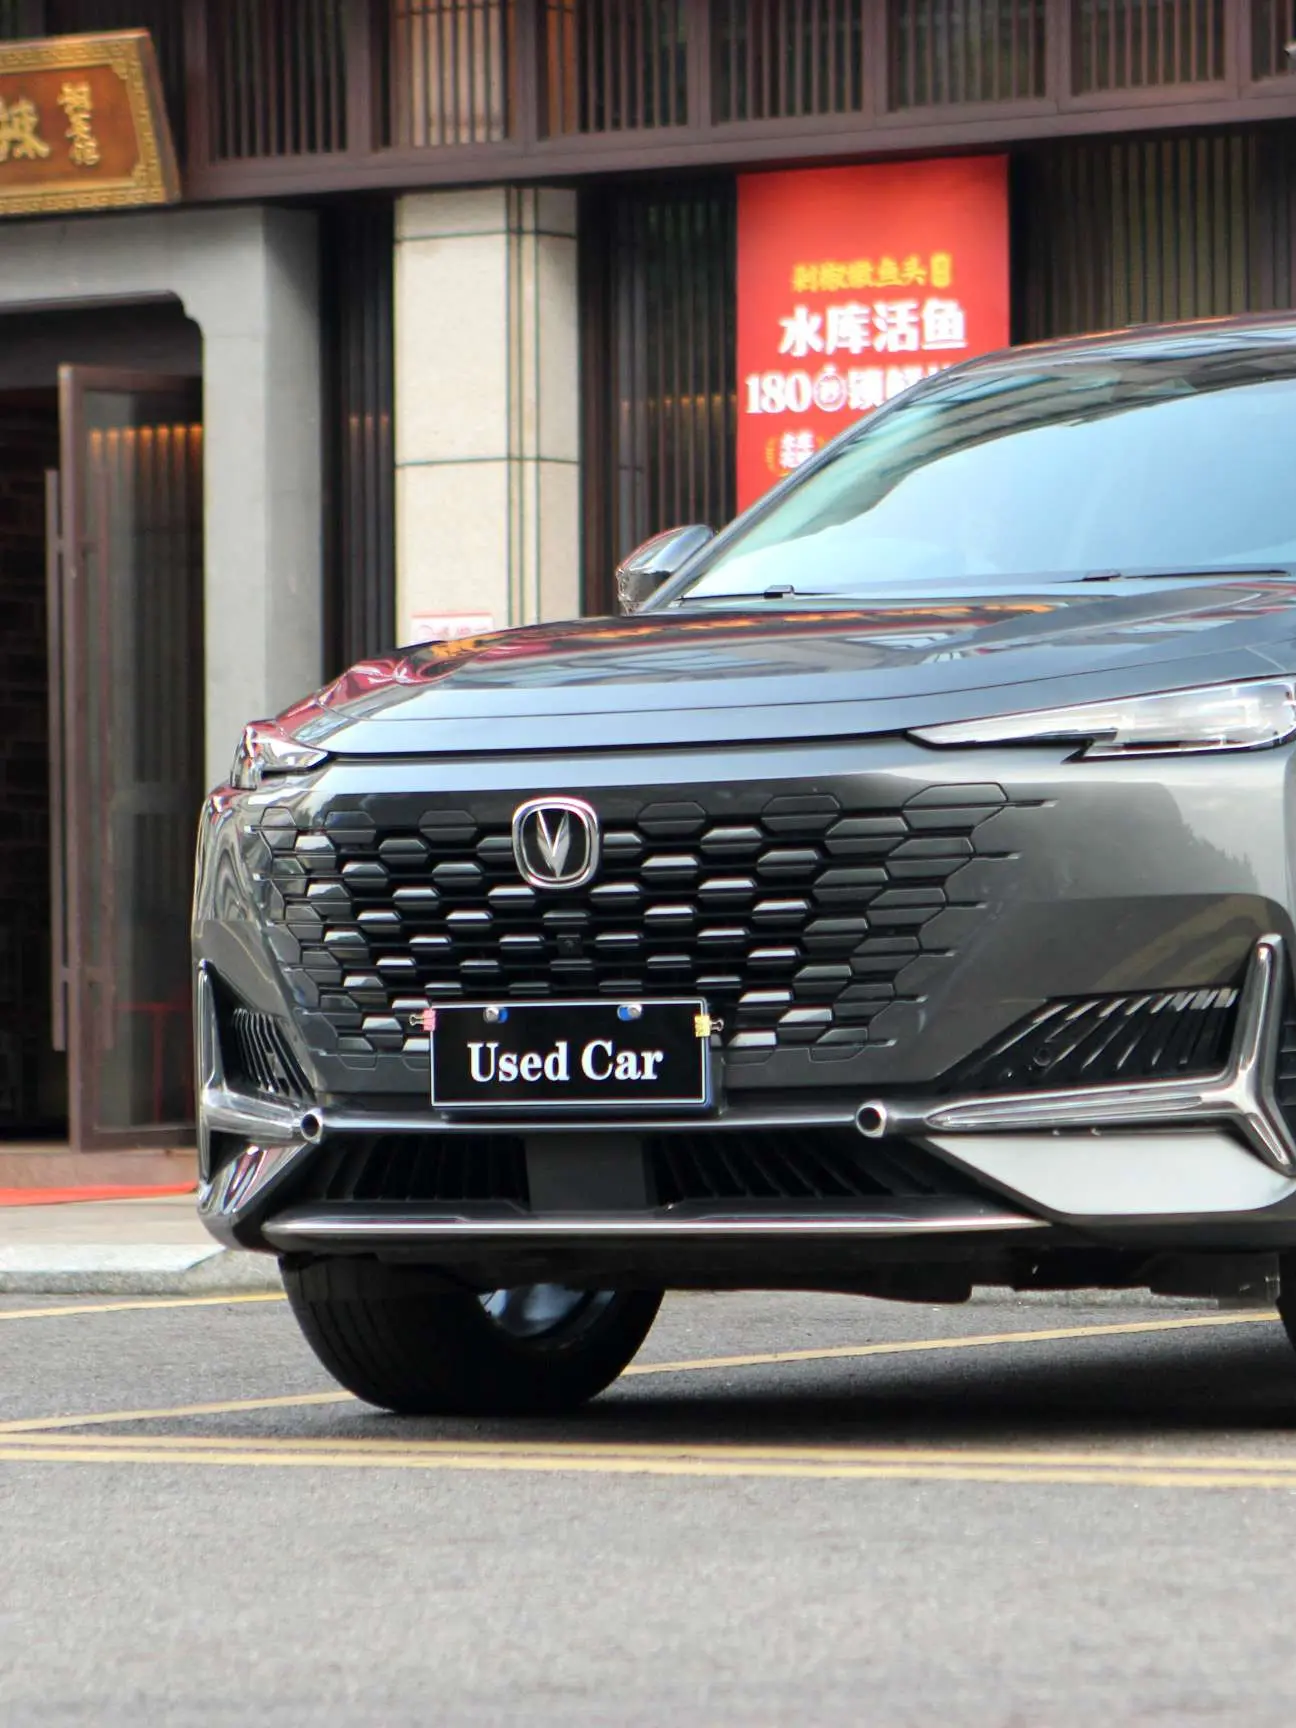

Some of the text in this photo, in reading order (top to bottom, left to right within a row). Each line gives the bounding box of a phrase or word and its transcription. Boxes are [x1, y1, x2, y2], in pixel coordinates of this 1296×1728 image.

[779, 297, 967, 357] 水库活鱼
[467, 1040, 663, 1082] Used Car
